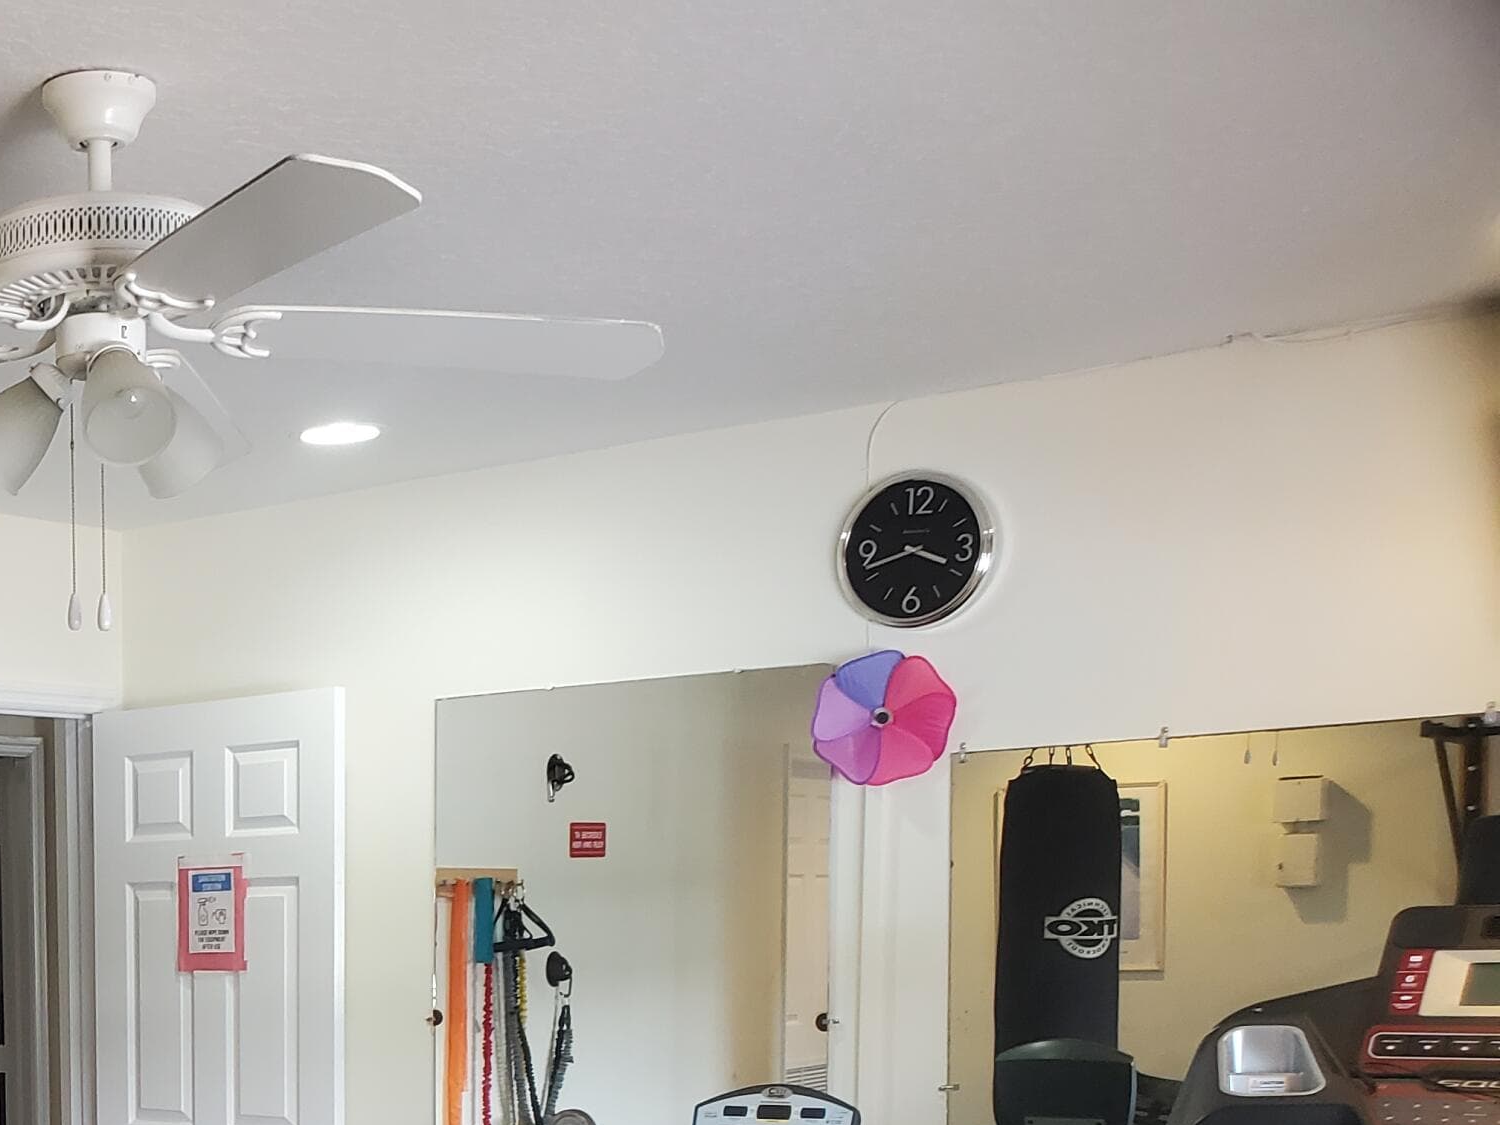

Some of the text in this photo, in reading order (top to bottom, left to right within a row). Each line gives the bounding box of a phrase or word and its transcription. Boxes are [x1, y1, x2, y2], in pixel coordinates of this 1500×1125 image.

[905, 486, 934, 515] 12
[859, 539, 878, 567] 9
[955, 533, 973, 562] 3
[902, 586, 921, 614] 6
